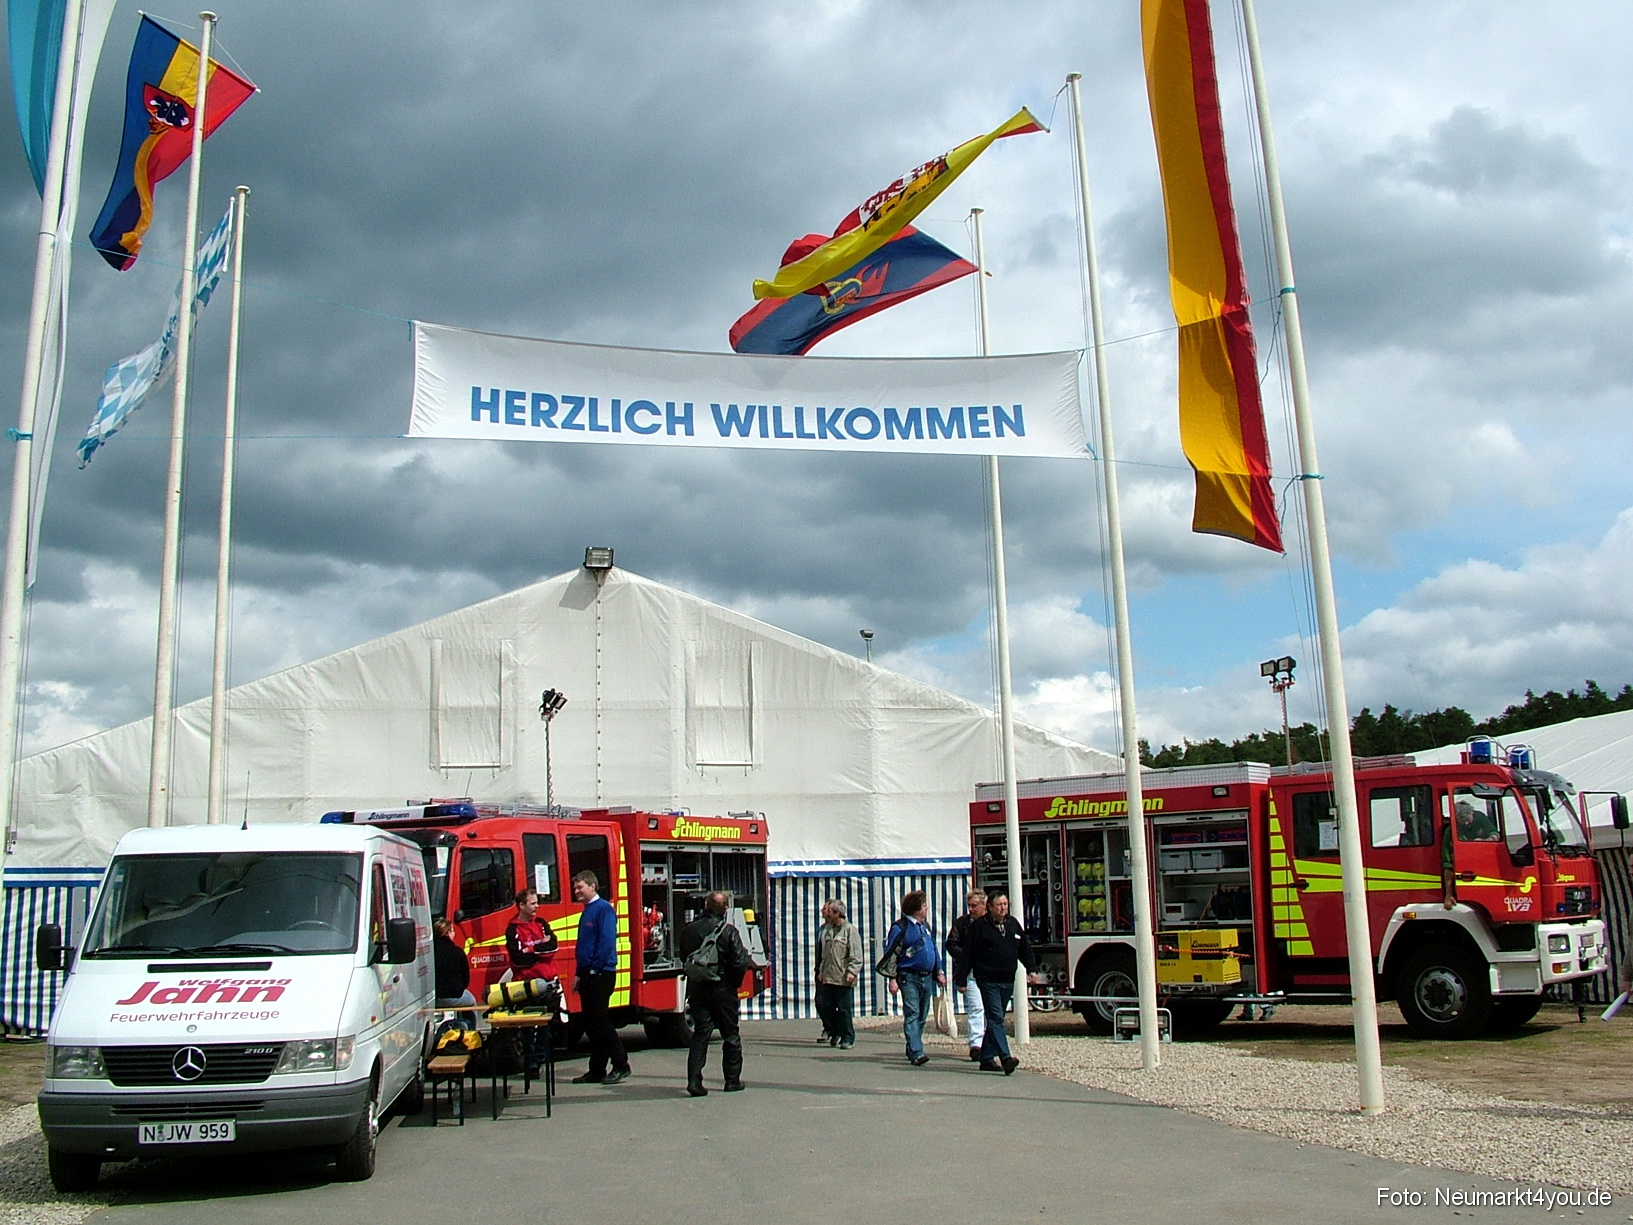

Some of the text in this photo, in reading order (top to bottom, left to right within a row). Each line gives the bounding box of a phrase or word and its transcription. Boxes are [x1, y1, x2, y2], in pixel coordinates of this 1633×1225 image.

[470, 386, 1026, 440] HERZLICH WILLKOMMEN
[1043, 797, 1164, 818] Schlingmnn
[671, 816, 741, 841] Schlingmann
[1504, 896, 1533, 907] QUADRA
[178, 978, 293, 987] Wolfgang
[115, 981, 286, 1005] Jahn
[109, 1010, 280, 1023] Feuerwehrfahrzeuge
[144, 1123, 229, 1141] N JW 959
